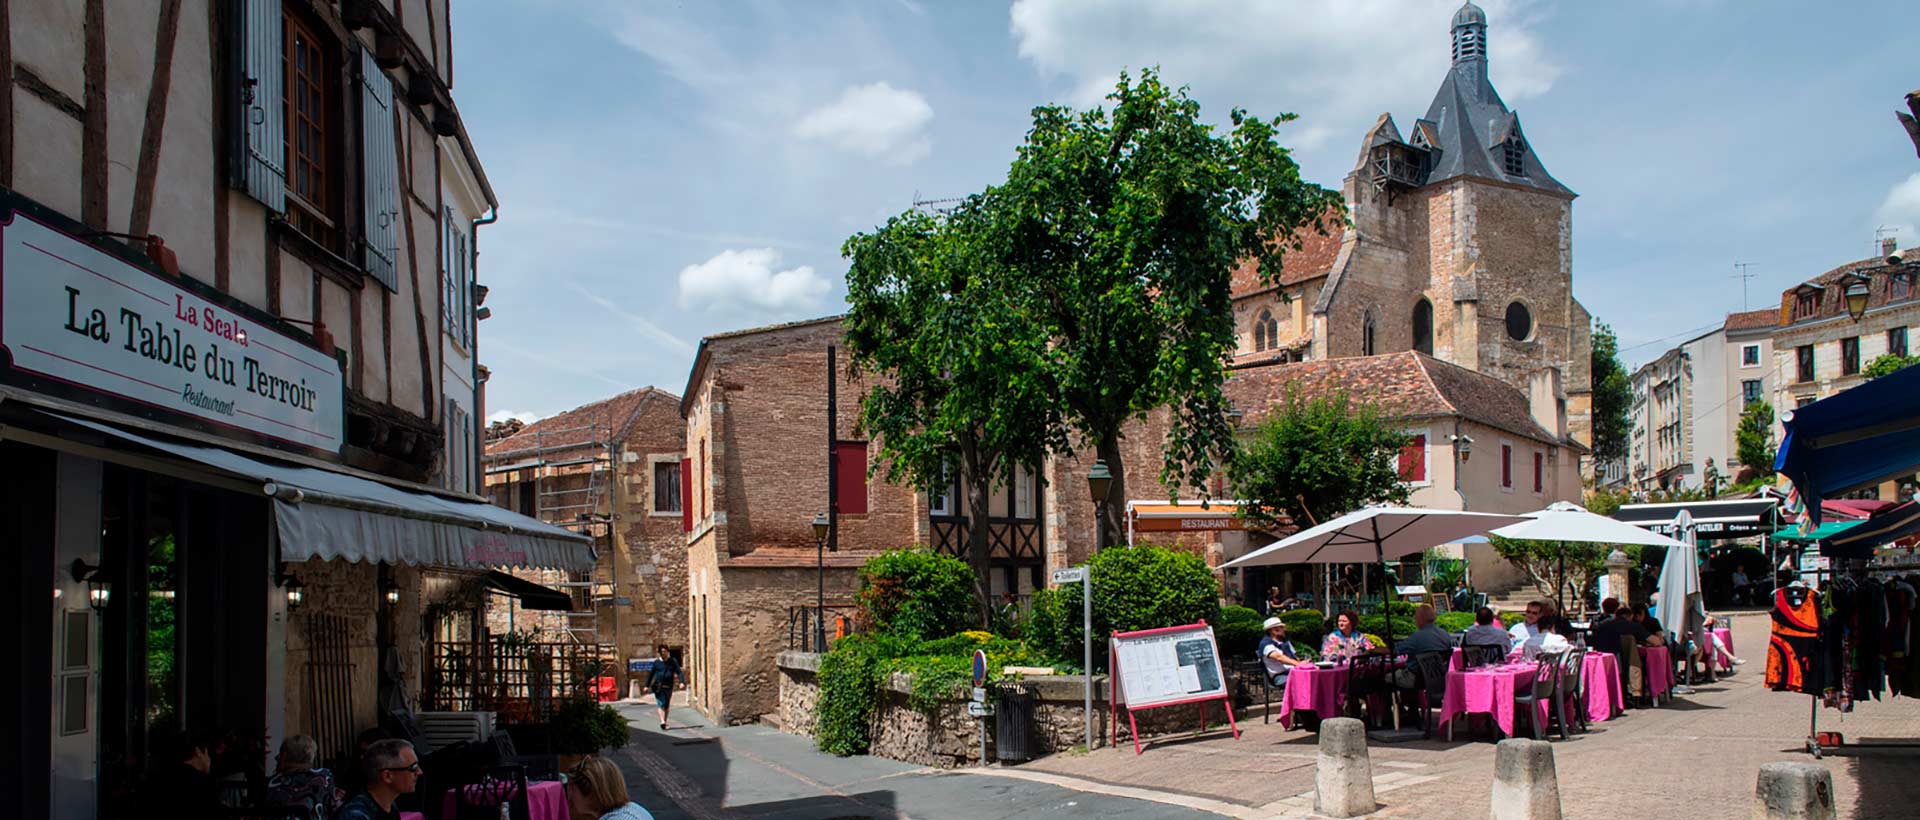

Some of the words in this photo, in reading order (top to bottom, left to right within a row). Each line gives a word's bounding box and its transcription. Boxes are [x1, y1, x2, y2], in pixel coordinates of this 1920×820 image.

[175, 293, 198, 327] La
[203, 307, 249, 348] Scala
[64, 285, 110, 344] La
[120, 307, 197, 373] Table
[204, 343, 236, 387] du
[243, 356, 317, 413] Terroir
[182, 383, 235, 417] Restaurant
[1181, 519, 1230, 529] RESTAURANT
[1696, 523, 1724, 532] BATELIER
